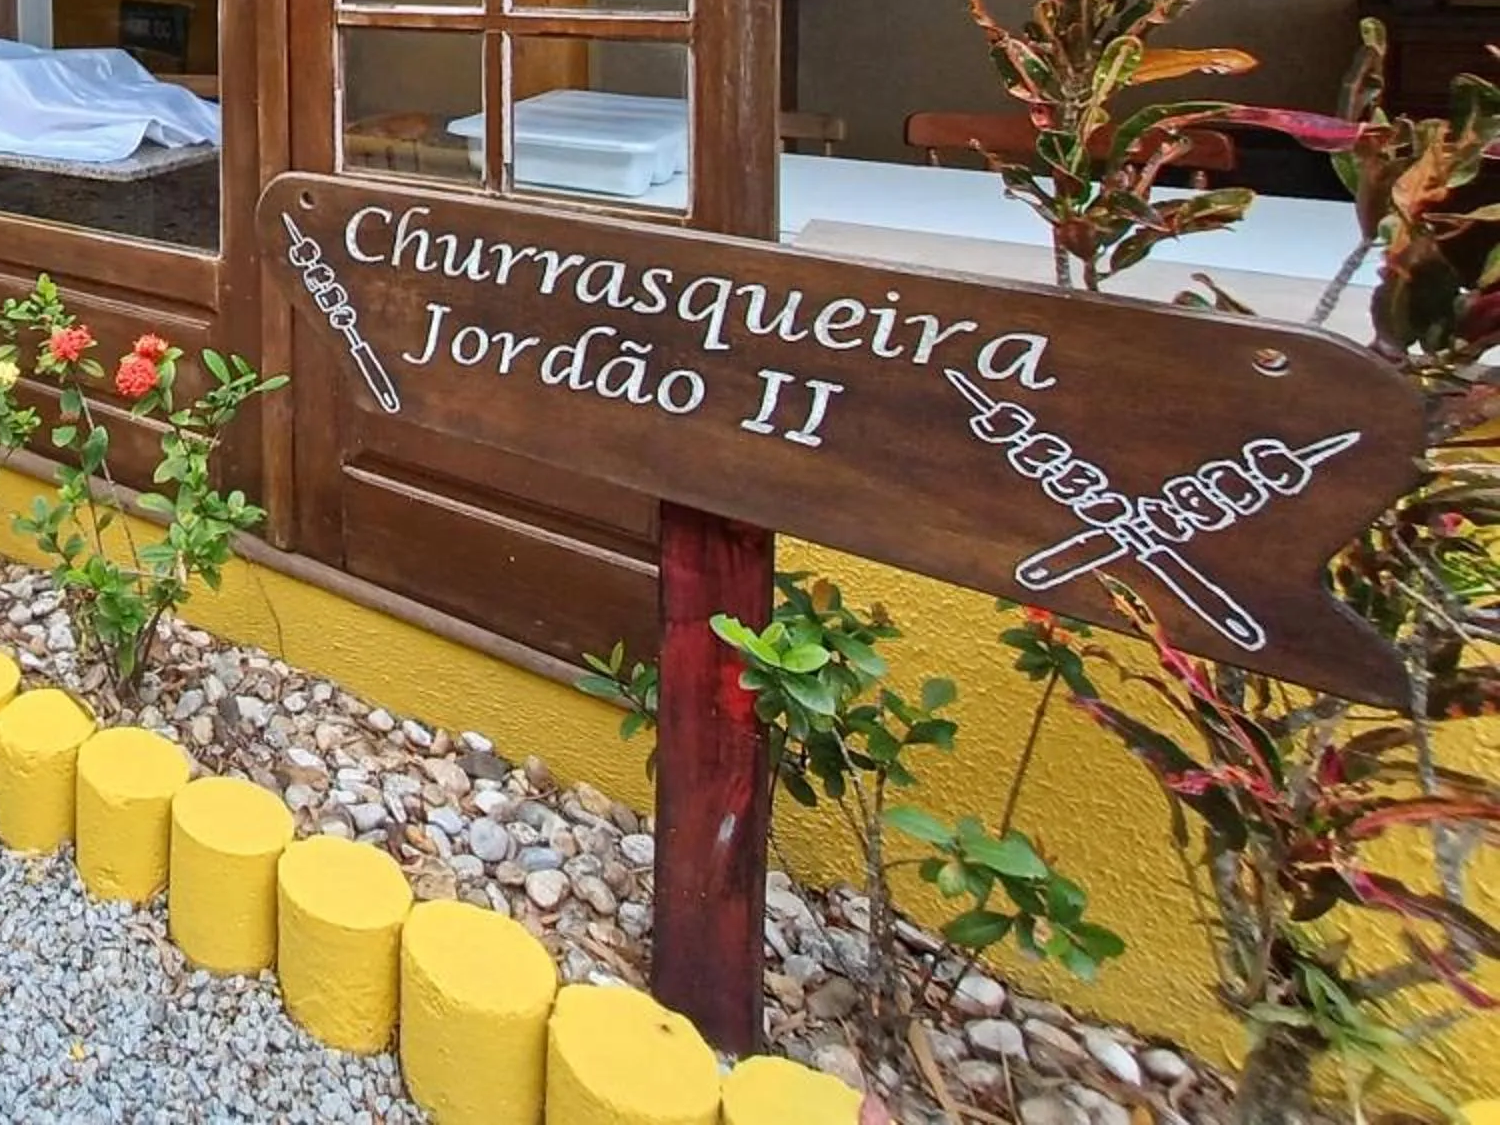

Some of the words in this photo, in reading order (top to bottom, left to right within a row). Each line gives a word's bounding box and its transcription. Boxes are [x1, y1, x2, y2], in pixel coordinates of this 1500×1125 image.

[344, 205, 1057, 391] Churrasqueira
[402, 302, 706, 414] Jordão
[740, 368, 844, 447] II
